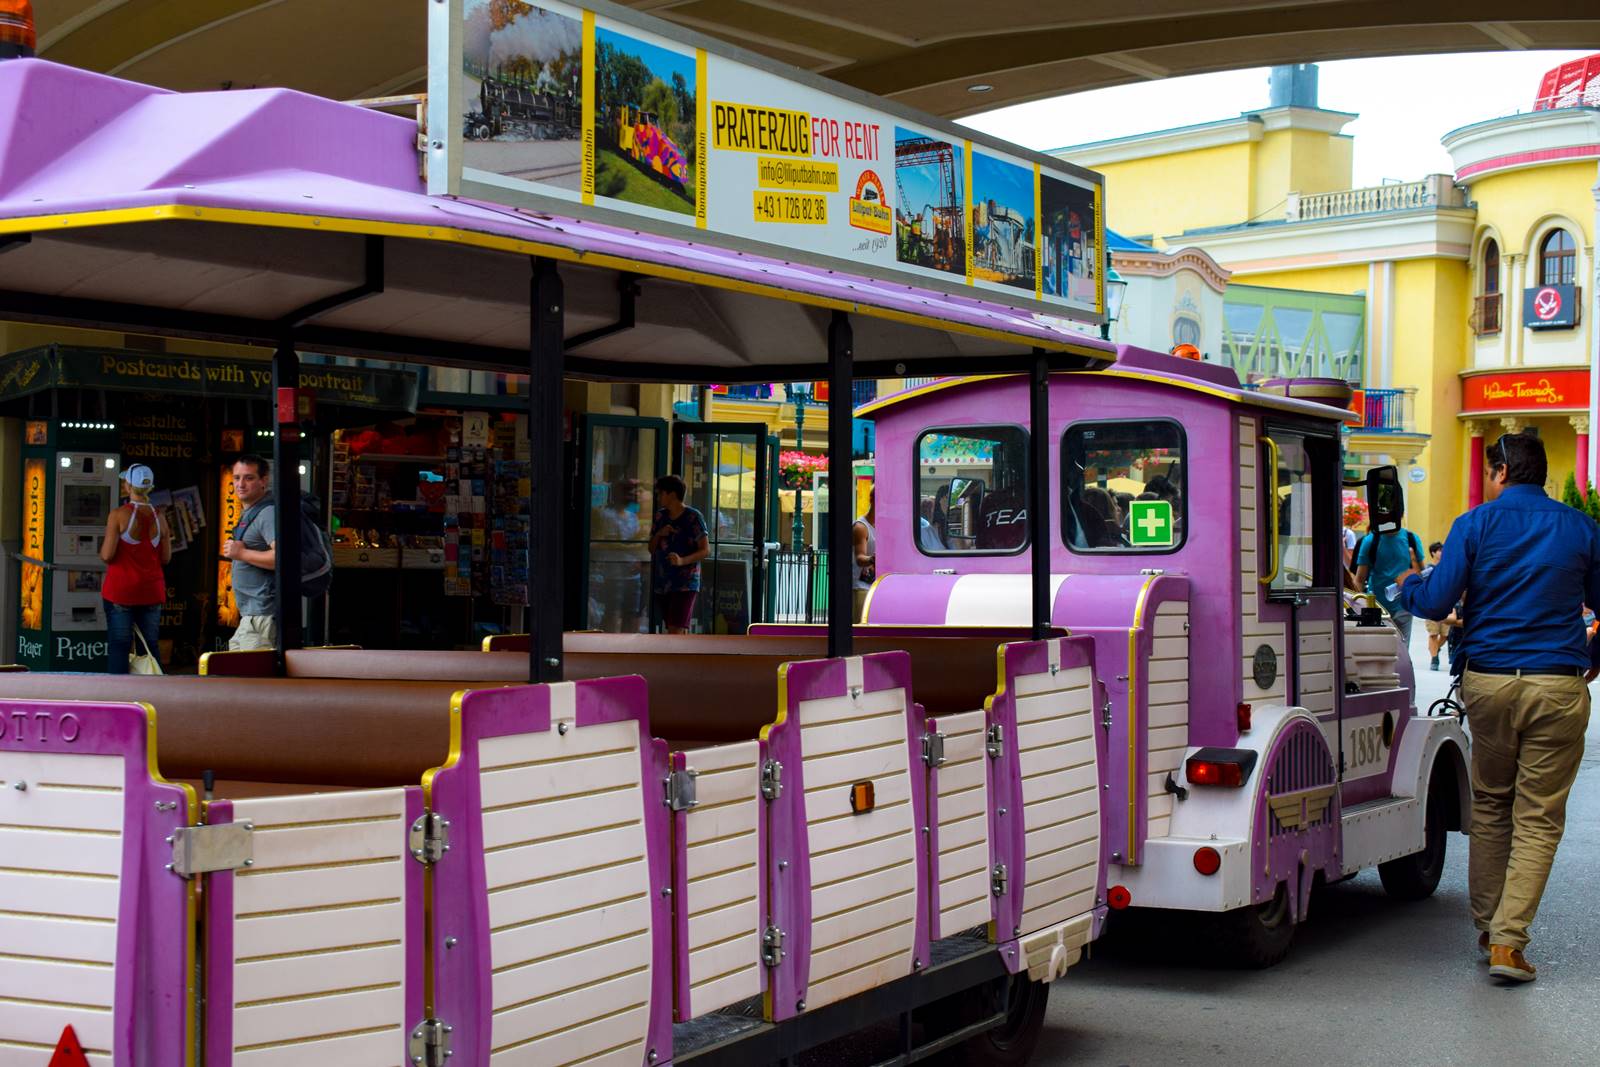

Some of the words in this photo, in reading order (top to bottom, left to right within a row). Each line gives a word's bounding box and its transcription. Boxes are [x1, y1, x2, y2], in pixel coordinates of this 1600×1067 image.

[715, 104, 809, 154] PRATERZUG
[811, 117, 840, 158] FOR
[845, 121, 880, 161] RENT
[584, 128, 593, 195] Liliputbahn
[698, 132, 707, 219] Donauparkbahn
[761, 161, 837, 187] info@liliputbahn.com
[757, 195, 775, 219] +43
[777, 196, 782, 218] 1
[785, 196, 800, 220] 726
[802, 198, 813, 220] 82
[815, 199, 825, 221] 36
[102, 354, 201, 381] Postcards
[205, 362, 245, 384] with
[249, 366, 273, 390] yo
[298, 372, 364, 392] portrait
[28, 476, 40, 549] photo
[224, 481, 236, 542] hoto
[18, 635, 43, 659] Prater
[1350, 724, 1383, 769] 1887
